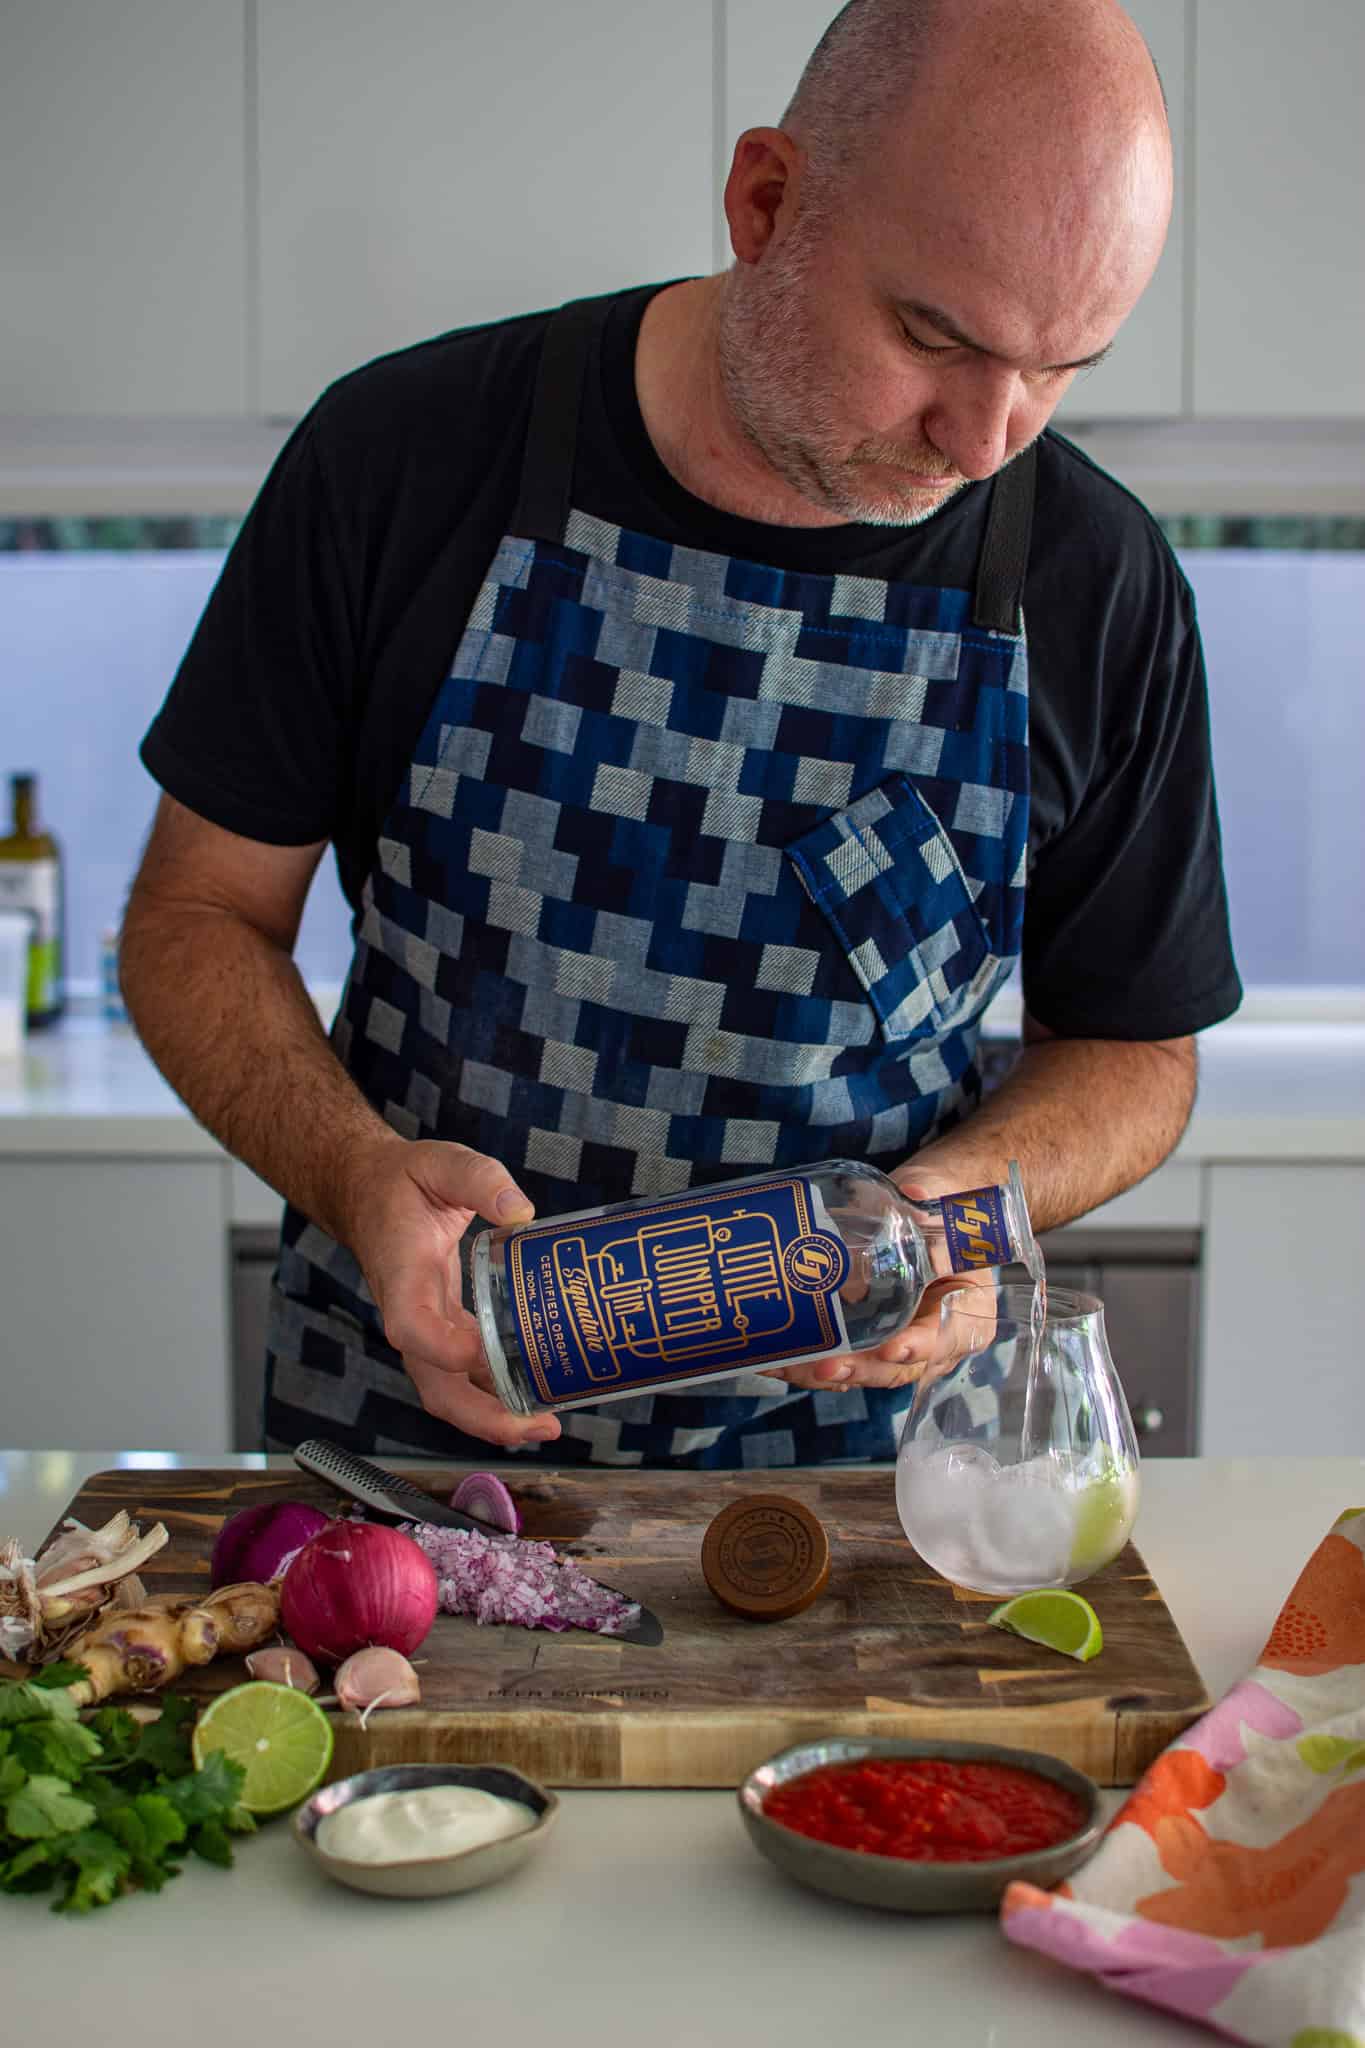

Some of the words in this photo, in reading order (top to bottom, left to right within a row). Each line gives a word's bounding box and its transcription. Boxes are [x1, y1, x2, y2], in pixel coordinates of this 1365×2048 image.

[525, 1269, 537, 1302] 700ML
[561, 1267, 605, 1353] Signature
[652, 1243, 723, 1332] JUNIPER
[717, 1241, 782, 1311] LITTLE
[532, 1311, 543, 1330] 42%
[535, 1332, 553, 1368] ALC/VOL
[541, 1255, 560, 1320] CERTIFIED
[551, 1323, 575, 1377] ORGANIC
